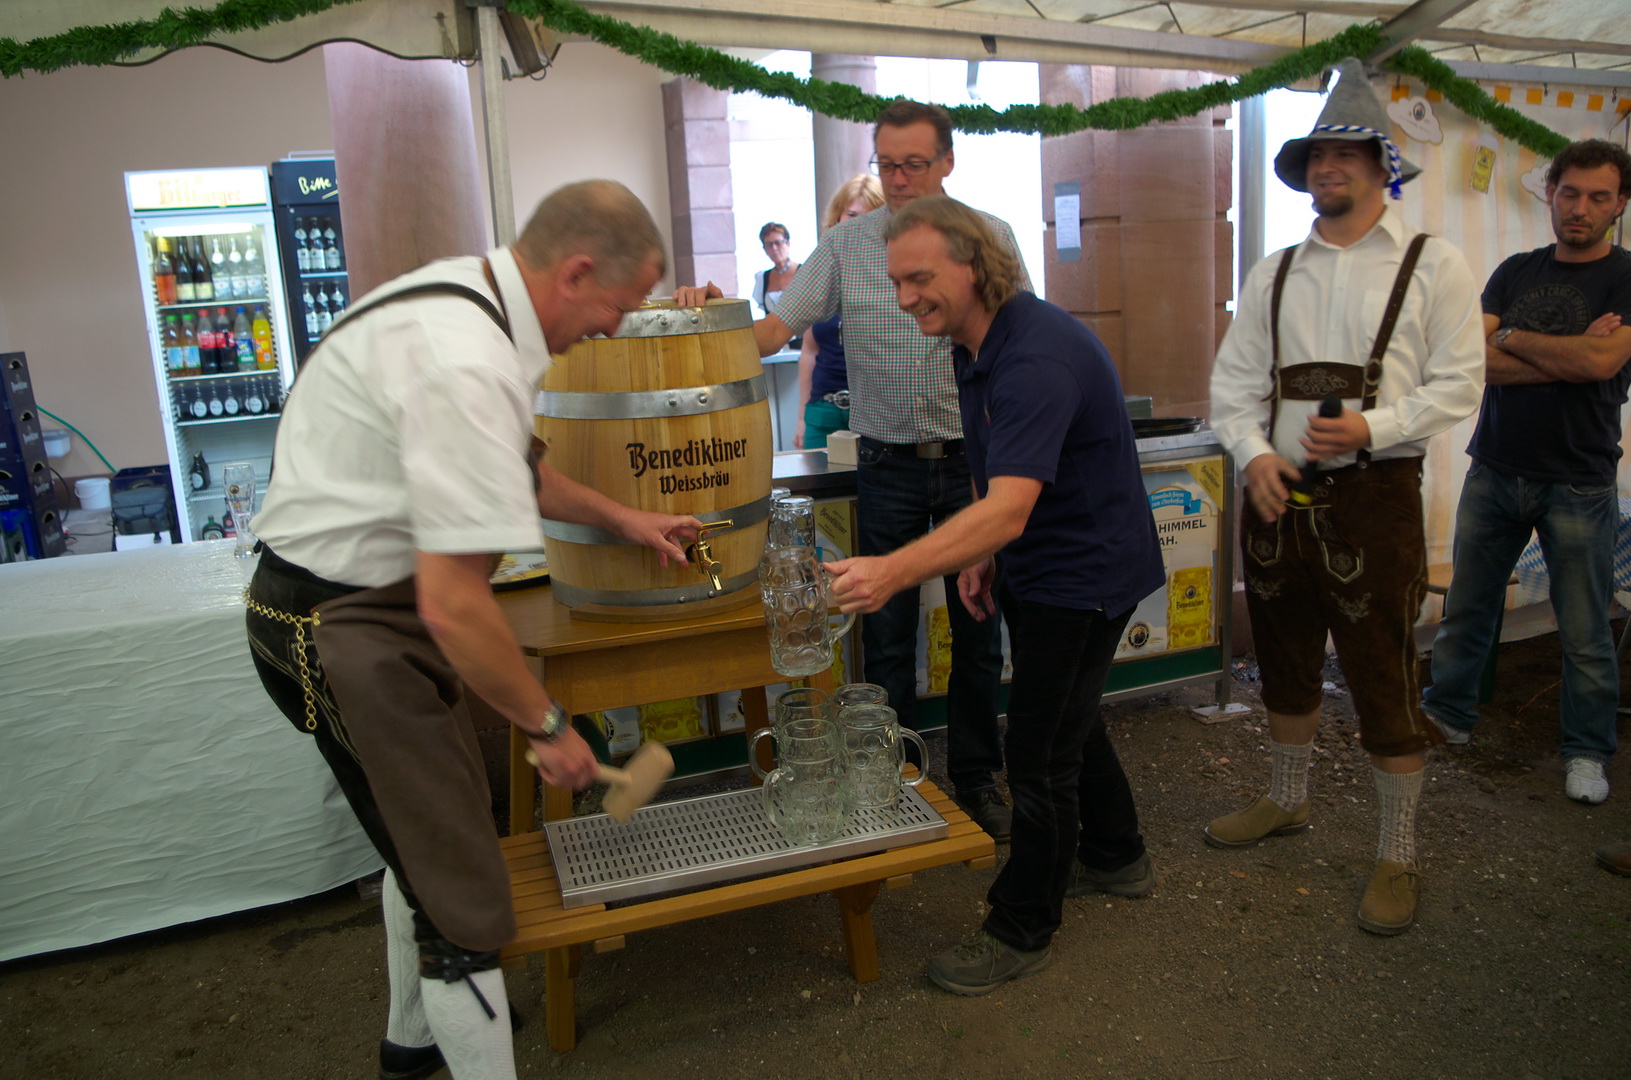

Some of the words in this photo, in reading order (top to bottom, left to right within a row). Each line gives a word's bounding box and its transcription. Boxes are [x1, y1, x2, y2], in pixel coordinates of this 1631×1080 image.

[298, 176, 333, 195] Bitte
[625, 437, 748, 478] Benediktiner
[658, 471, 730, 496] Weissbräu
[1158, 518, 1207, 534] HIMMEL
